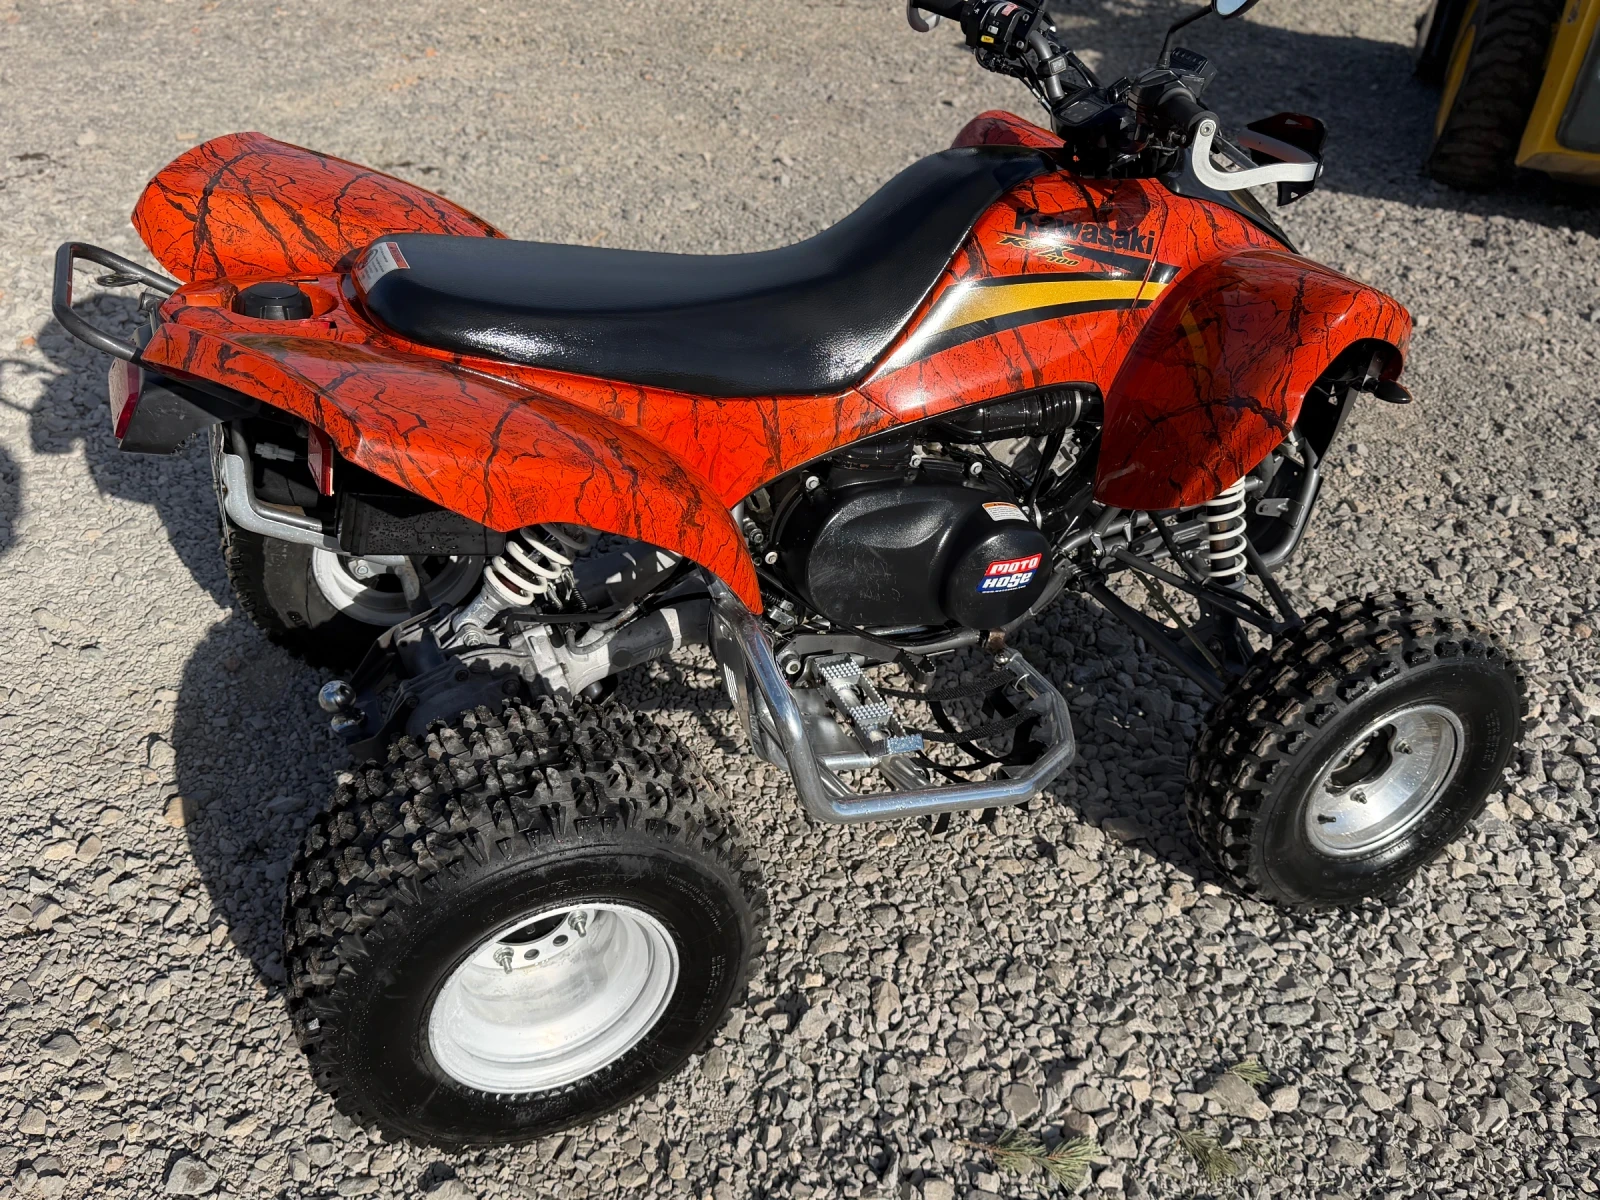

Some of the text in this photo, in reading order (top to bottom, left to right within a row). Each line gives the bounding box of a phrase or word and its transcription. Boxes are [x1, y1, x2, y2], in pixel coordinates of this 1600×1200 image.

[1014, 207, 1156, 255] Kawasaki
[996, 234, 1075, 257] KX
[1046, 255, 1080, 266] 400
[989, 557, 1039, 575] MOTO
